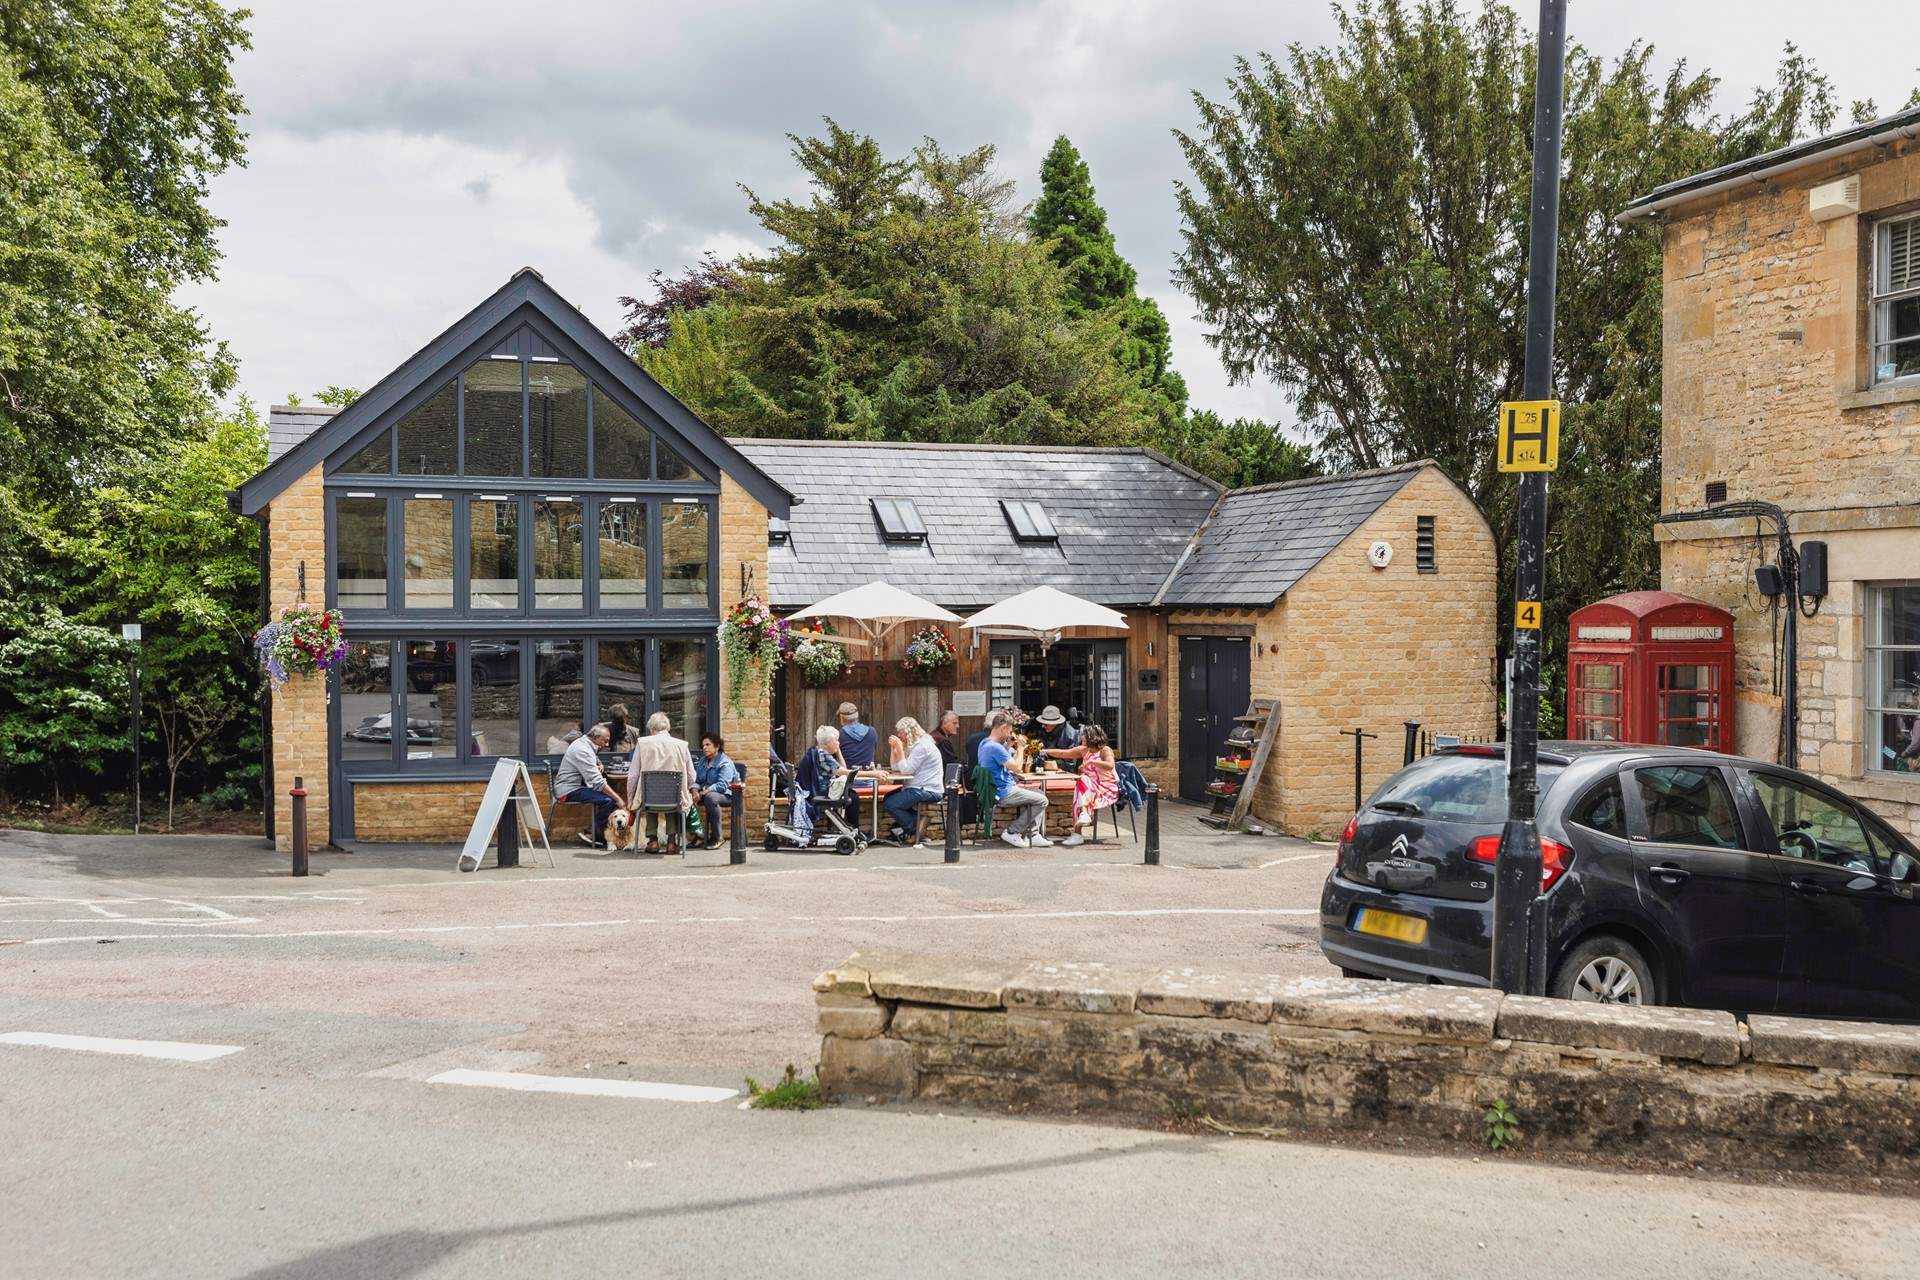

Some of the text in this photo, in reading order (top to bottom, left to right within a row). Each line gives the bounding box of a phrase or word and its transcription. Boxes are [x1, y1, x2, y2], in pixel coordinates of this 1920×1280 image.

[1525, 412, 1537, 423] 75
[1507, 408, 1549, 464] H
[1521, 606, 1535, 624] 4
[1470, 881, 1487, 889] C3
